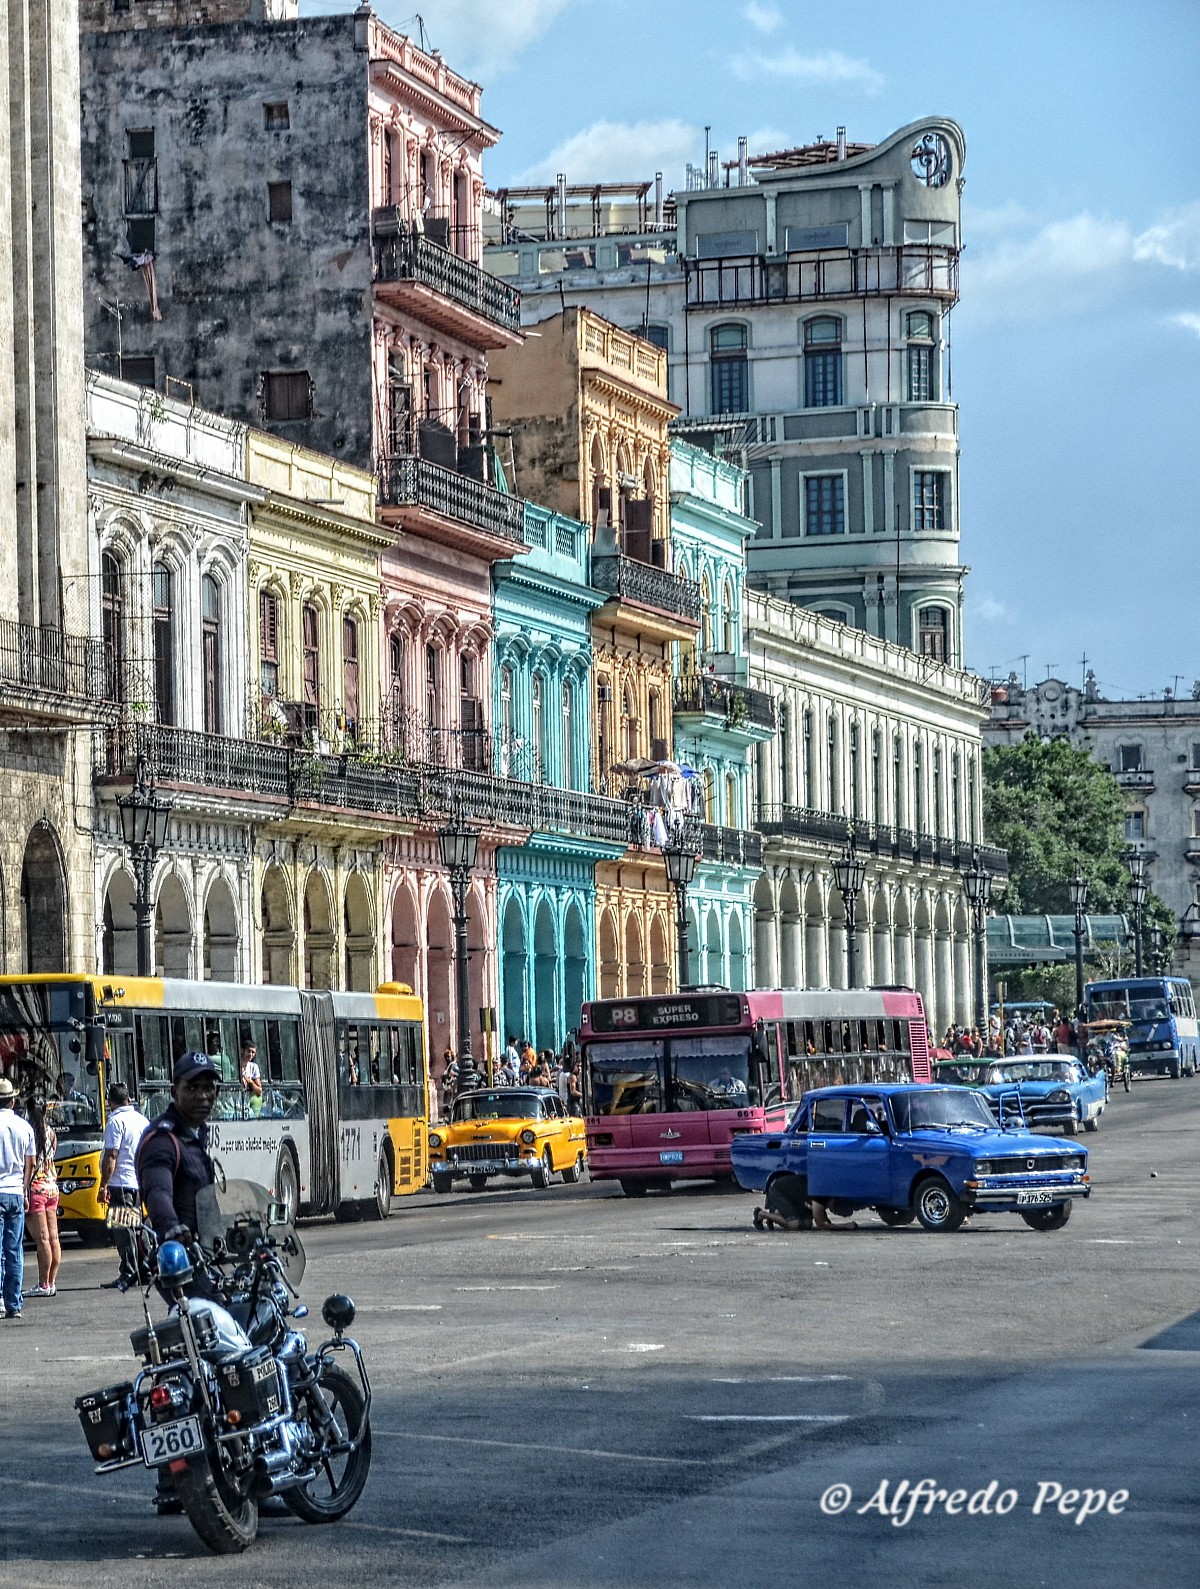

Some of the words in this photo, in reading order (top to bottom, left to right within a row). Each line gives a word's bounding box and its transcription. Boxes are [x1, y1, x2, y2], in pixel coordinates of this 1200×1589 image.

[611, 1008, 636, 1024] P8
[652, 1012, 699, 1024] EXPRESO
[737, 1110, 754, 1118] 661
[235, 1141, 244, 1150] una
[246, 1137, 261, 1151] ciudad
[341, 1127, 360, 1161] 1771
[55, 1164, 91, 1176] 771
[151, 1427, 194, 1459] 260
